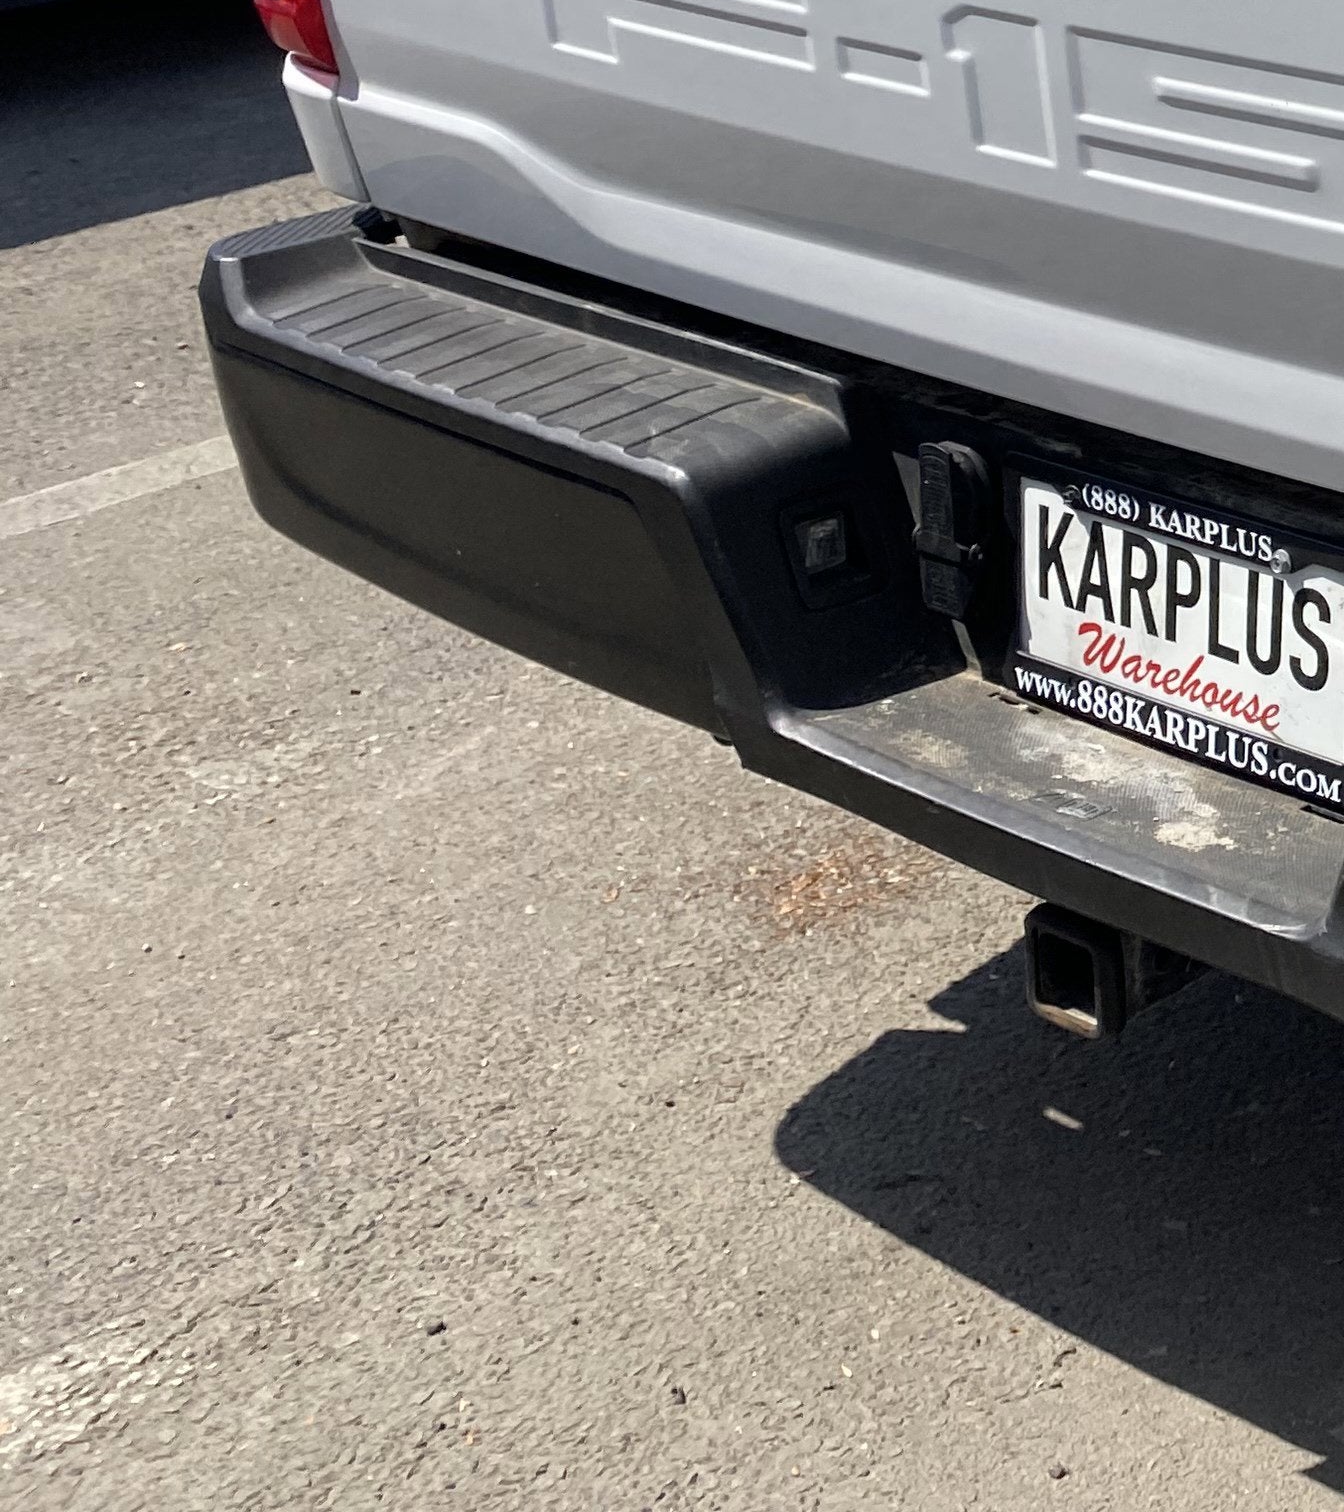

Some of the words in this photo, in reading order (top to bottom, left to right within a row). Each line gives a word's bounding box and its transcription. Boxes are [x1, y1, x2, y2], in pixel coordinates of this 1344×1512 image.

[1082, 484, 1140, 522] (888)
[1148, 502, 1273, 563] KARPLUS
[1037, 503, 1332, 692] KARPLUS
[1077, 621, 1281, 732] Warehouse
